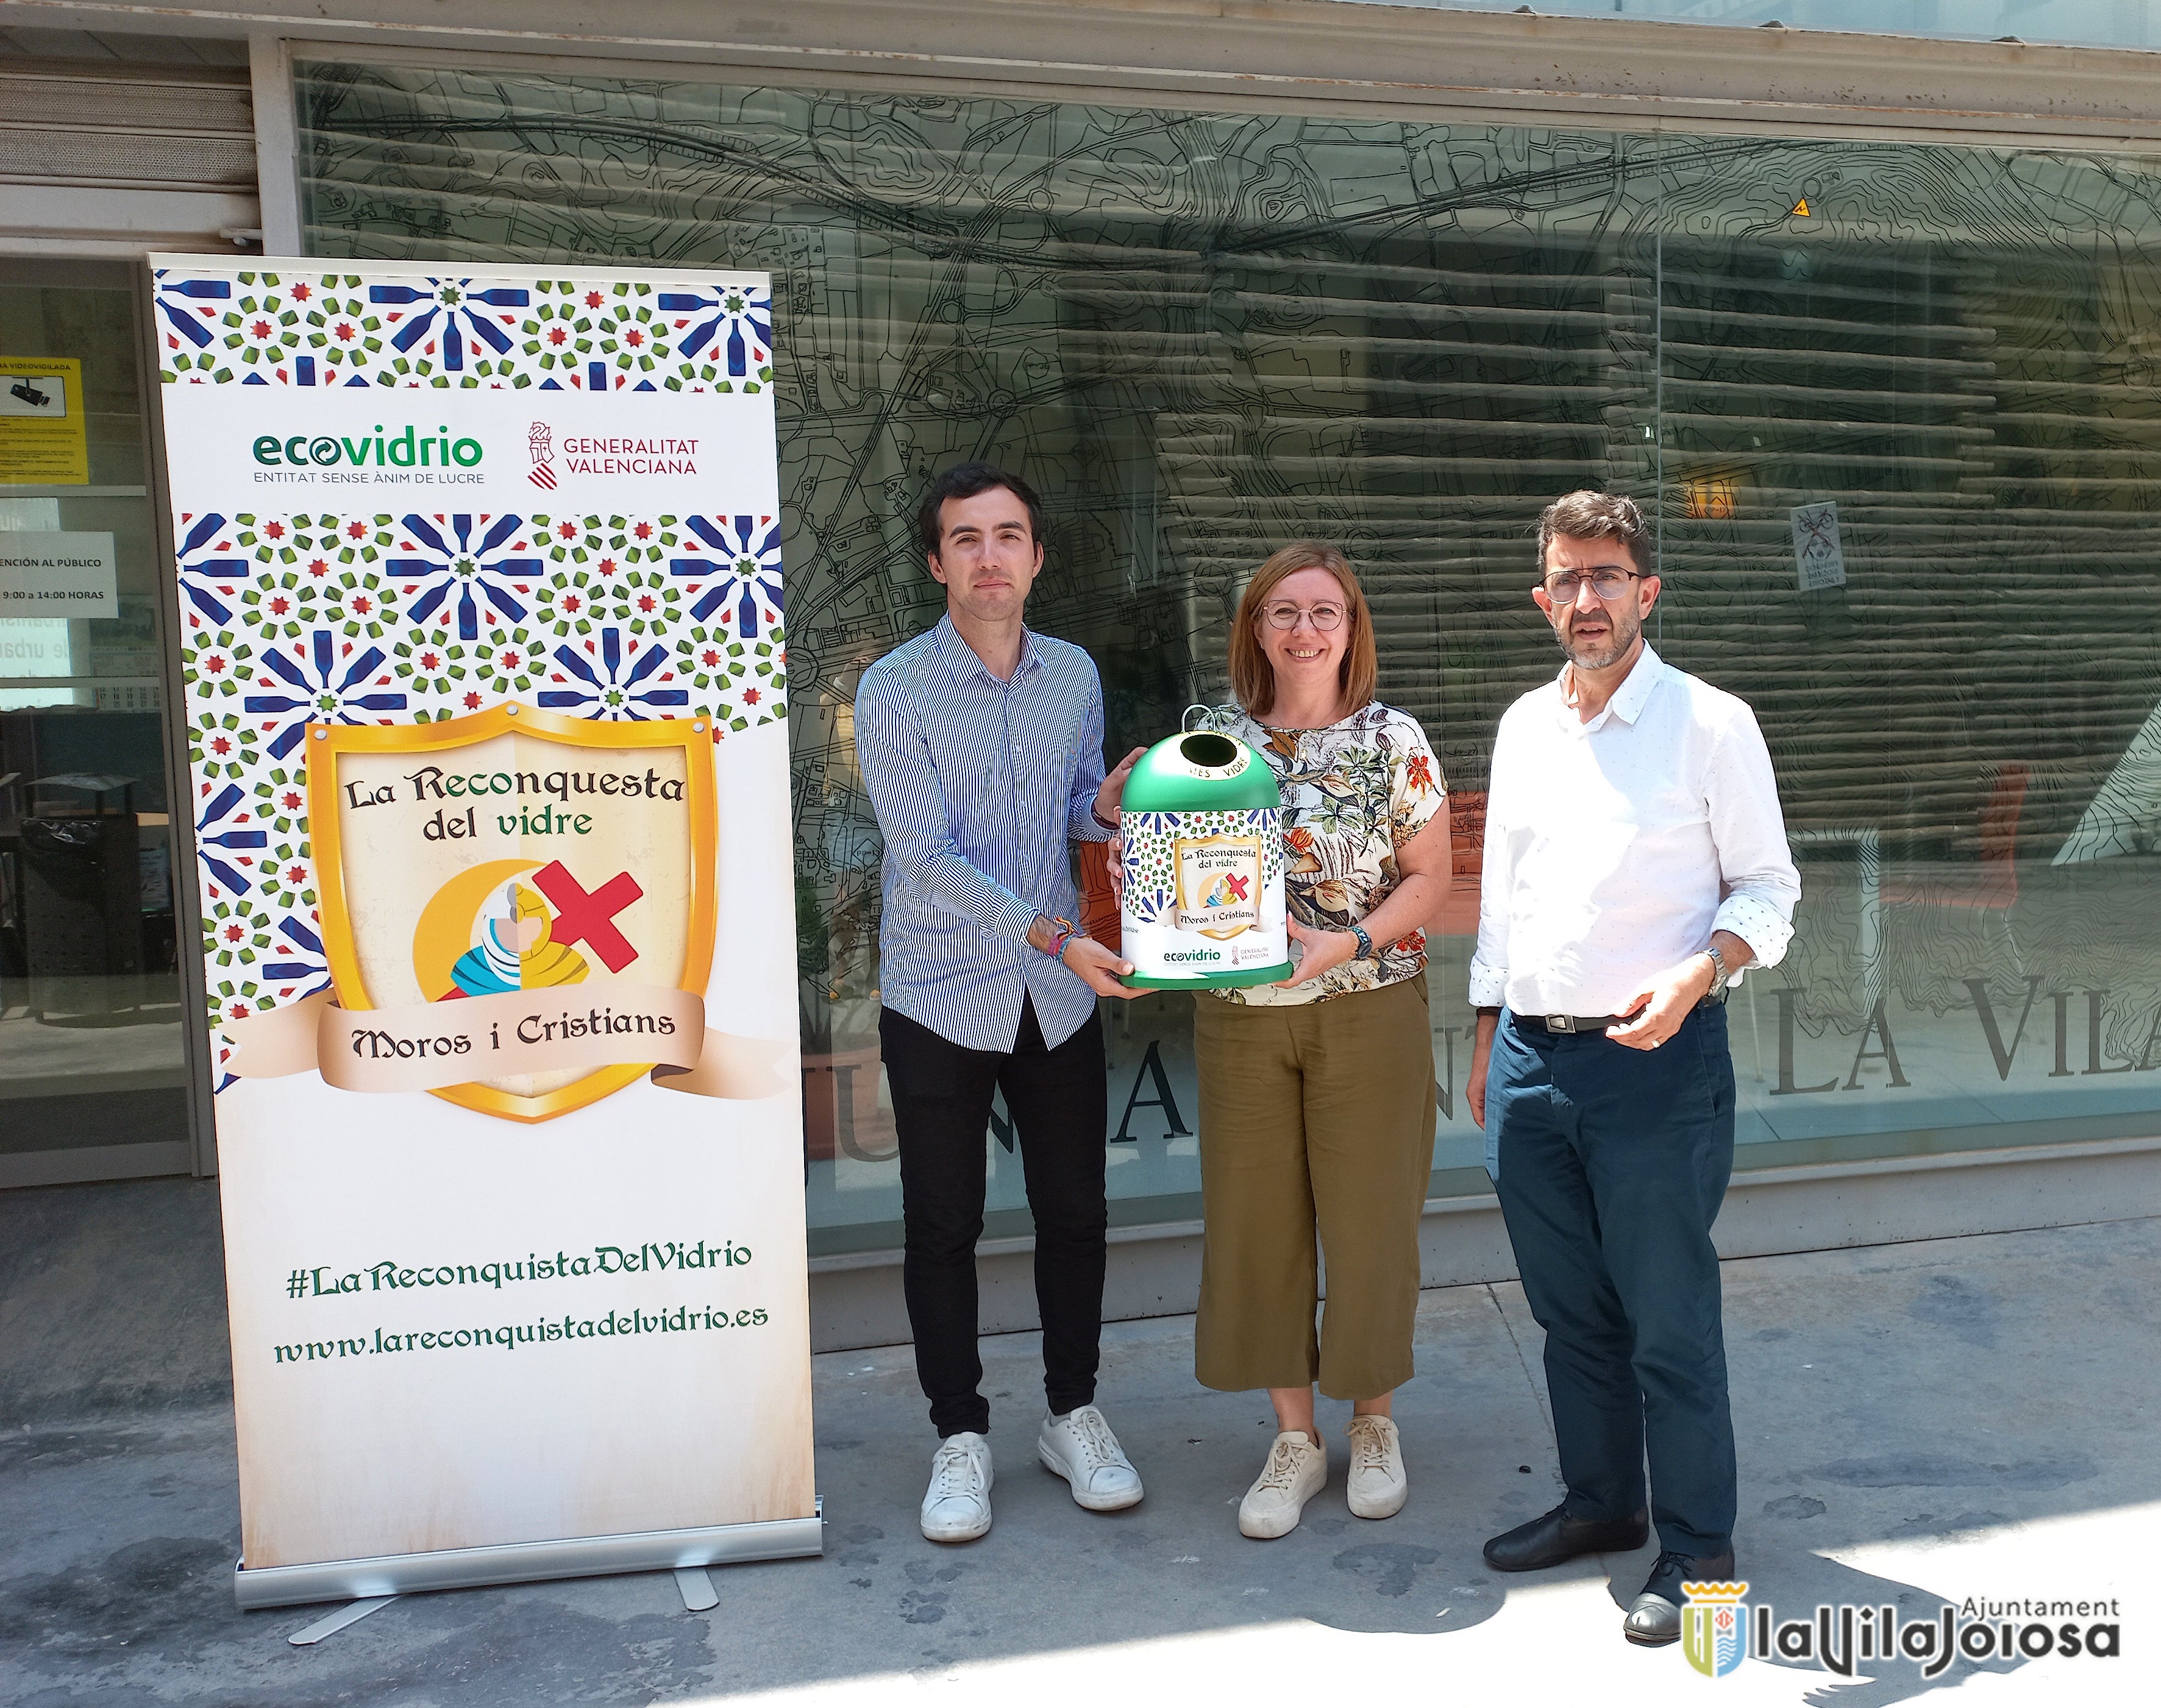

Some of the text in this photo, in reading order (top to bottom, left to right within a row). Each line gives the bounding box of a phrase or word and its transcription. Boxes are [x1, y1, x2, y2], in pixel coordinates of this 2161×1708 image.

[253, 424, 483, 467] ecovidrio
[564, 438, 699, 455] GENERALITAT
[566, 458, 697, 474] VALENCIANA
[254, 471, 485, 485] ENTITAT SENSE ÀNIM DE LUCRE
[57, 557, 101, 567] PÚBLICO
[2, 591, 25, 600] 9:00
[37, 591, 65, 600] 14:00
[68, 591, 104, 600] HORAS
[344, 766, 686, 810] La Reconquesta
[423, 805, 593, 841] del vidre
[1195, 849, 1256, 858] Reconquesta
[1198, 860, 1211, 869] del
[1180, 915, 1209, 924] Moros
[1219, 910, 1255, 920] Cristians
[1164, 948, 1221, 961] ecovidrio
[352, 1007, 676, 1059] Moros i Cristians
[1770, 987, 1912, 1096] LA
[286, 1240, 753, 1300] #LaReconquistaDelVidrio
[273, 1304, 769, 1364] www.lareconquistadelvidrio.es
